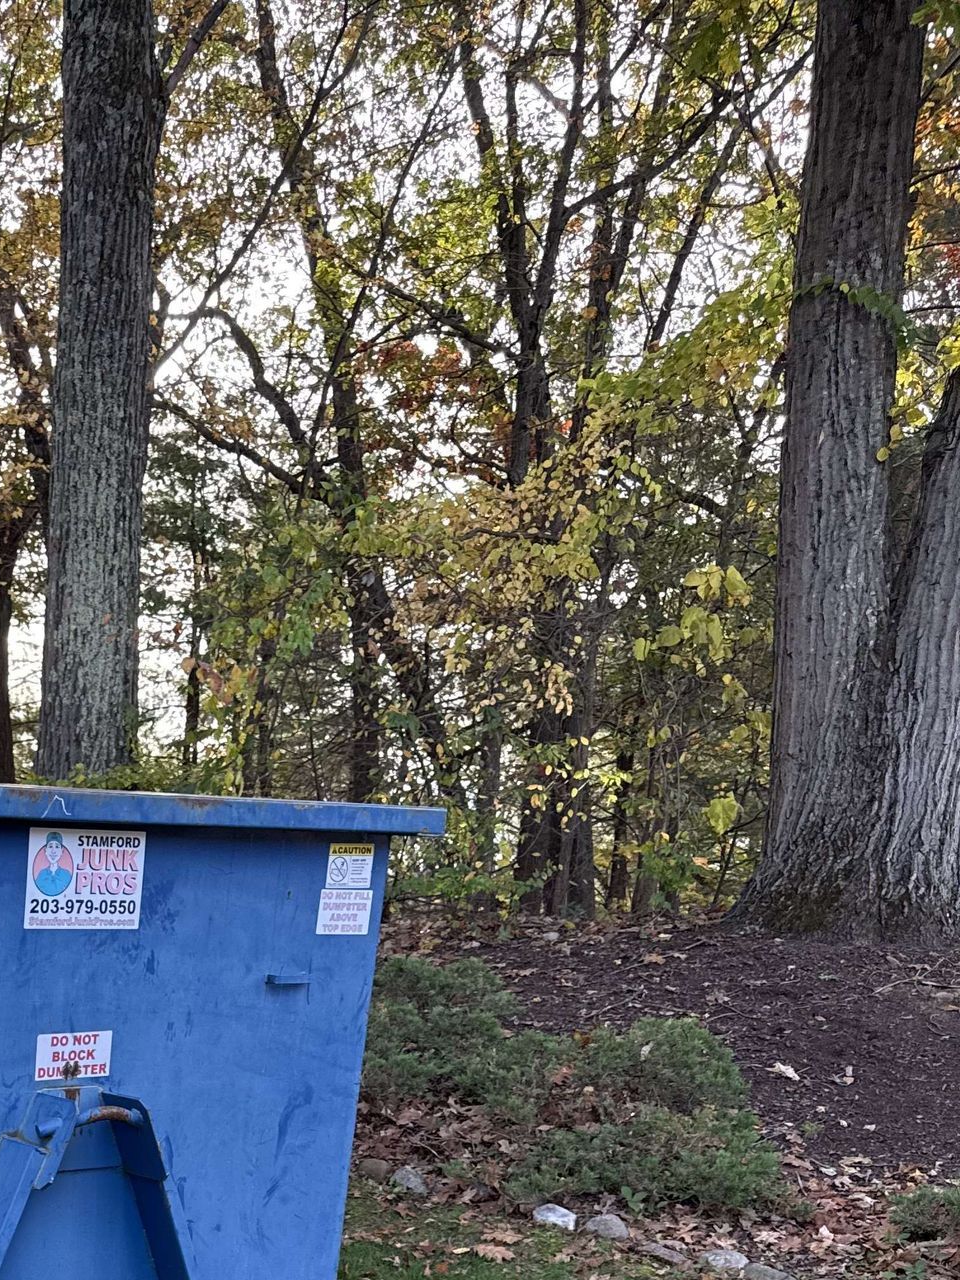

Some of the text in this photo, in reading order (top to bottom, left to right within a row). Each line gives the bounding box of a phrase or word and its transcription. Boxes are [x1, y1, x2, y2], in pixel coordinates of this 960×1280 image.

[77, 835, 141, 849] STAMFORD
[337, 846, 372, 854] CAUTION
[76, 848, 139, 872] JUNK
[75, 872, 138, 896] PROS
[322, 891, 371, 901] DO NOT FILL
[29, 898, 136, 915] 203-979-0550
[322, 902, 368, 912] DUMPSTER
[329, 913, 358, 922] ABOVE
[322, 924, 363, 933] TOP EDGE
[50, 1034, 99, 1047] DO NOT
[52, 1048, 96, 1062] BLOCK
[37, 1063, 107, 1079] DUMTER
